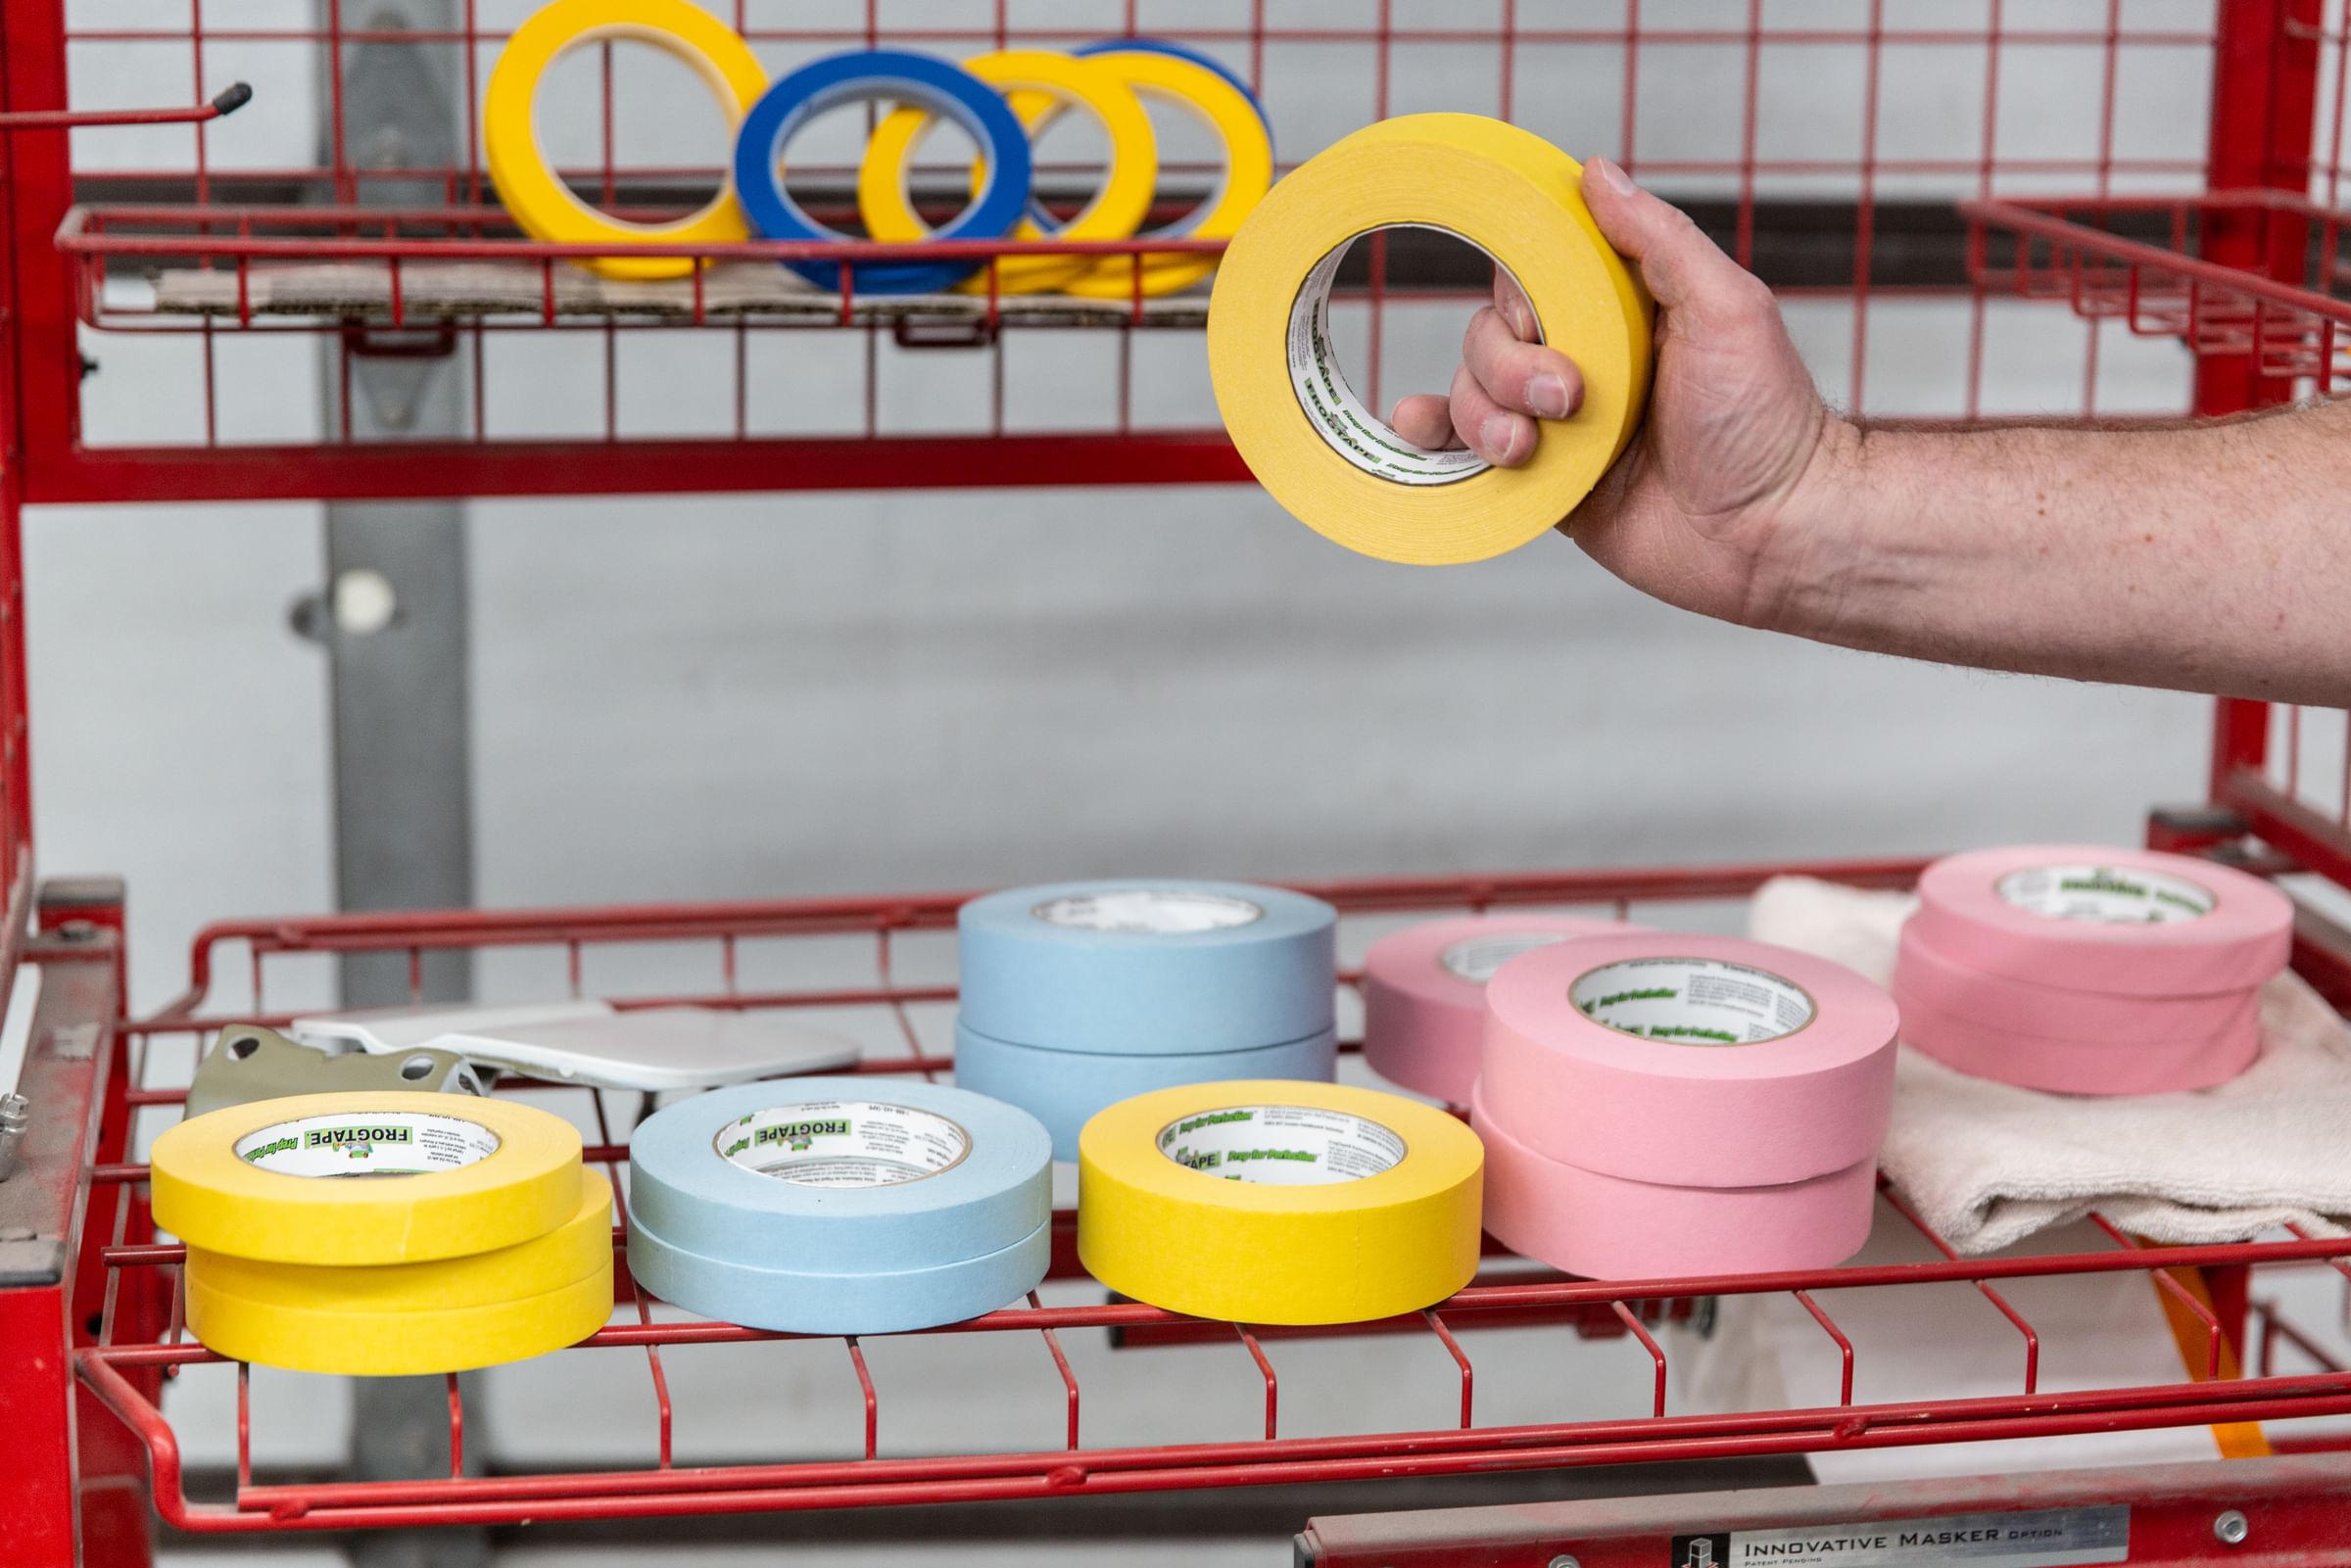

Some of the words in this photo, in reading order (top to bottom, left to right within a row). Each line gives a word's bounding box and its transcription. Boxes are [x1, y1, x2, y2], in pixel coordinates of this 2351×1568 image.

[1307, 381, 1376, 462] FROGTAPE
[310, 1128, 408, 1146] FROGTAPE
[759, 1121, 846, 1142] FROGTAPE
[1745, 1537, 1888, 1557] INNOVATIVE
[1899, 1529, 1999, 1546] MASKER
[2008, 1529, 2063, 1540] OPTION
